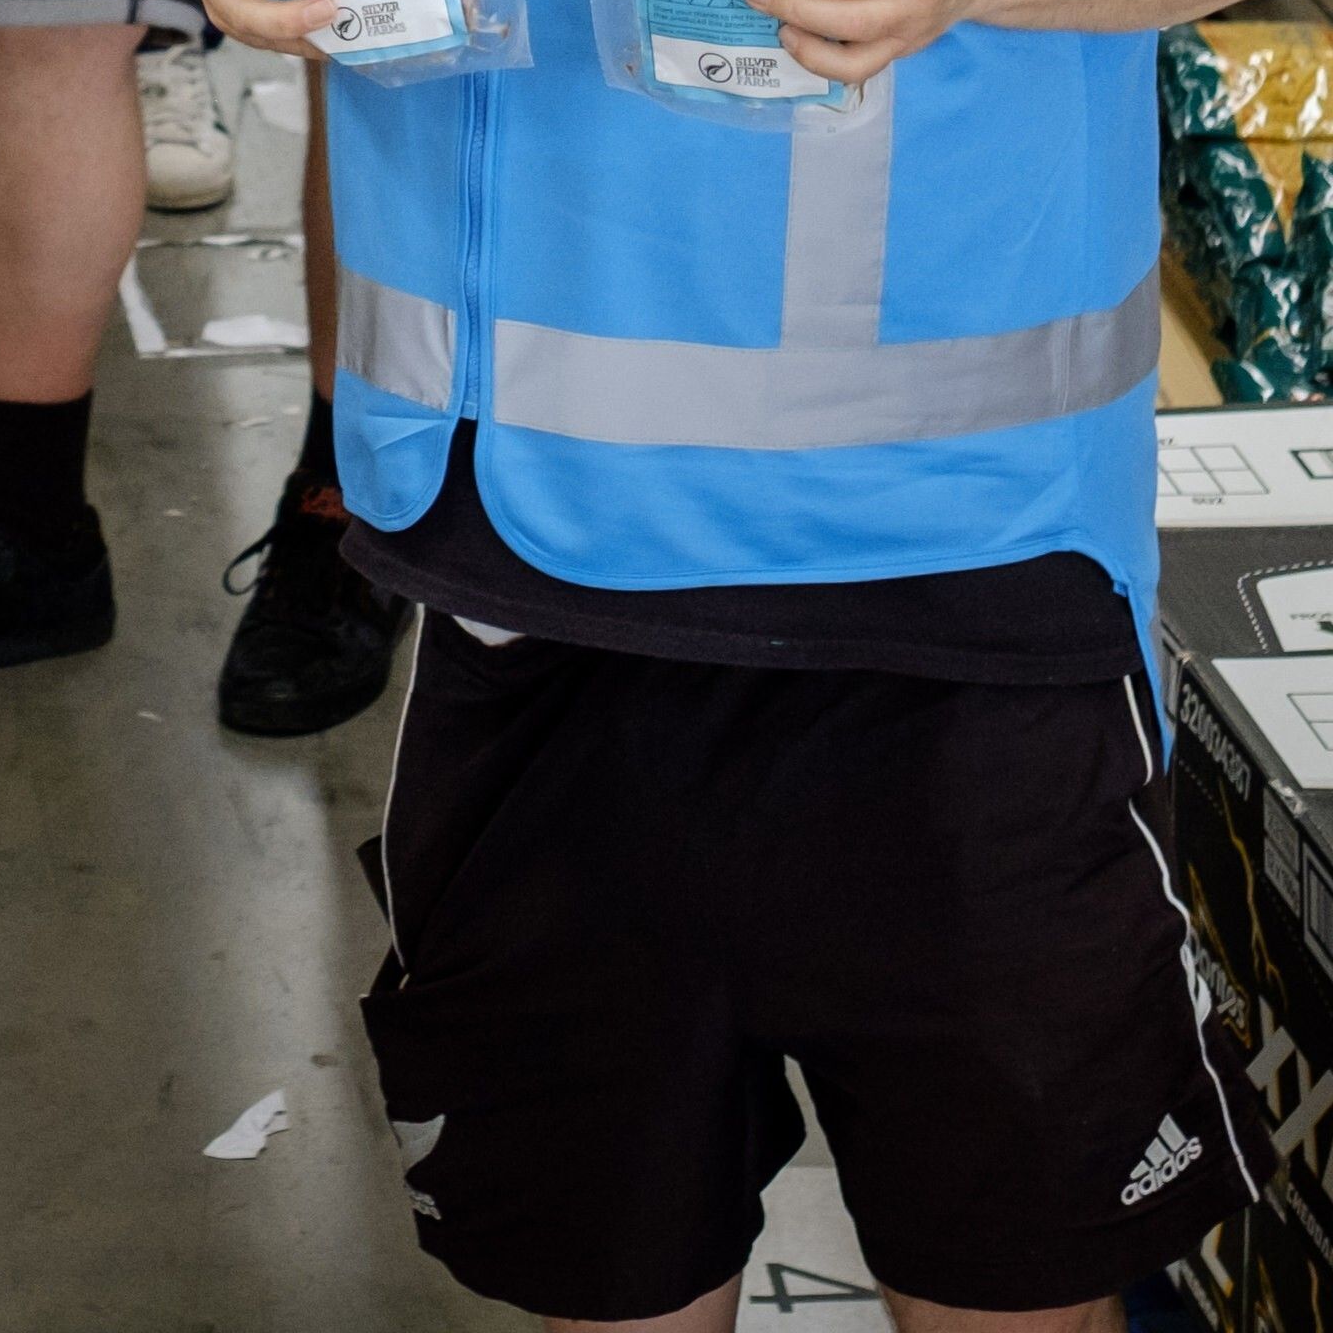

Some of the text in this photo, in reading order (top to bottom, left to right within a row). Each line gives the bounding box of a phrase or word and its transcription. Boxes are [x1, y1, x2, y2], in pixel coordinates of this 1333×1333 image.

[362, 1, 400, 15] SILVER
[365, 13, 395, 25] FERN
[736, 57, 778, 69] SILVER
[736, 67, 773, 78] FERN
[736, 76, 780, 88] FARMS
[1121, 1136, 1202, 1205] adidas
